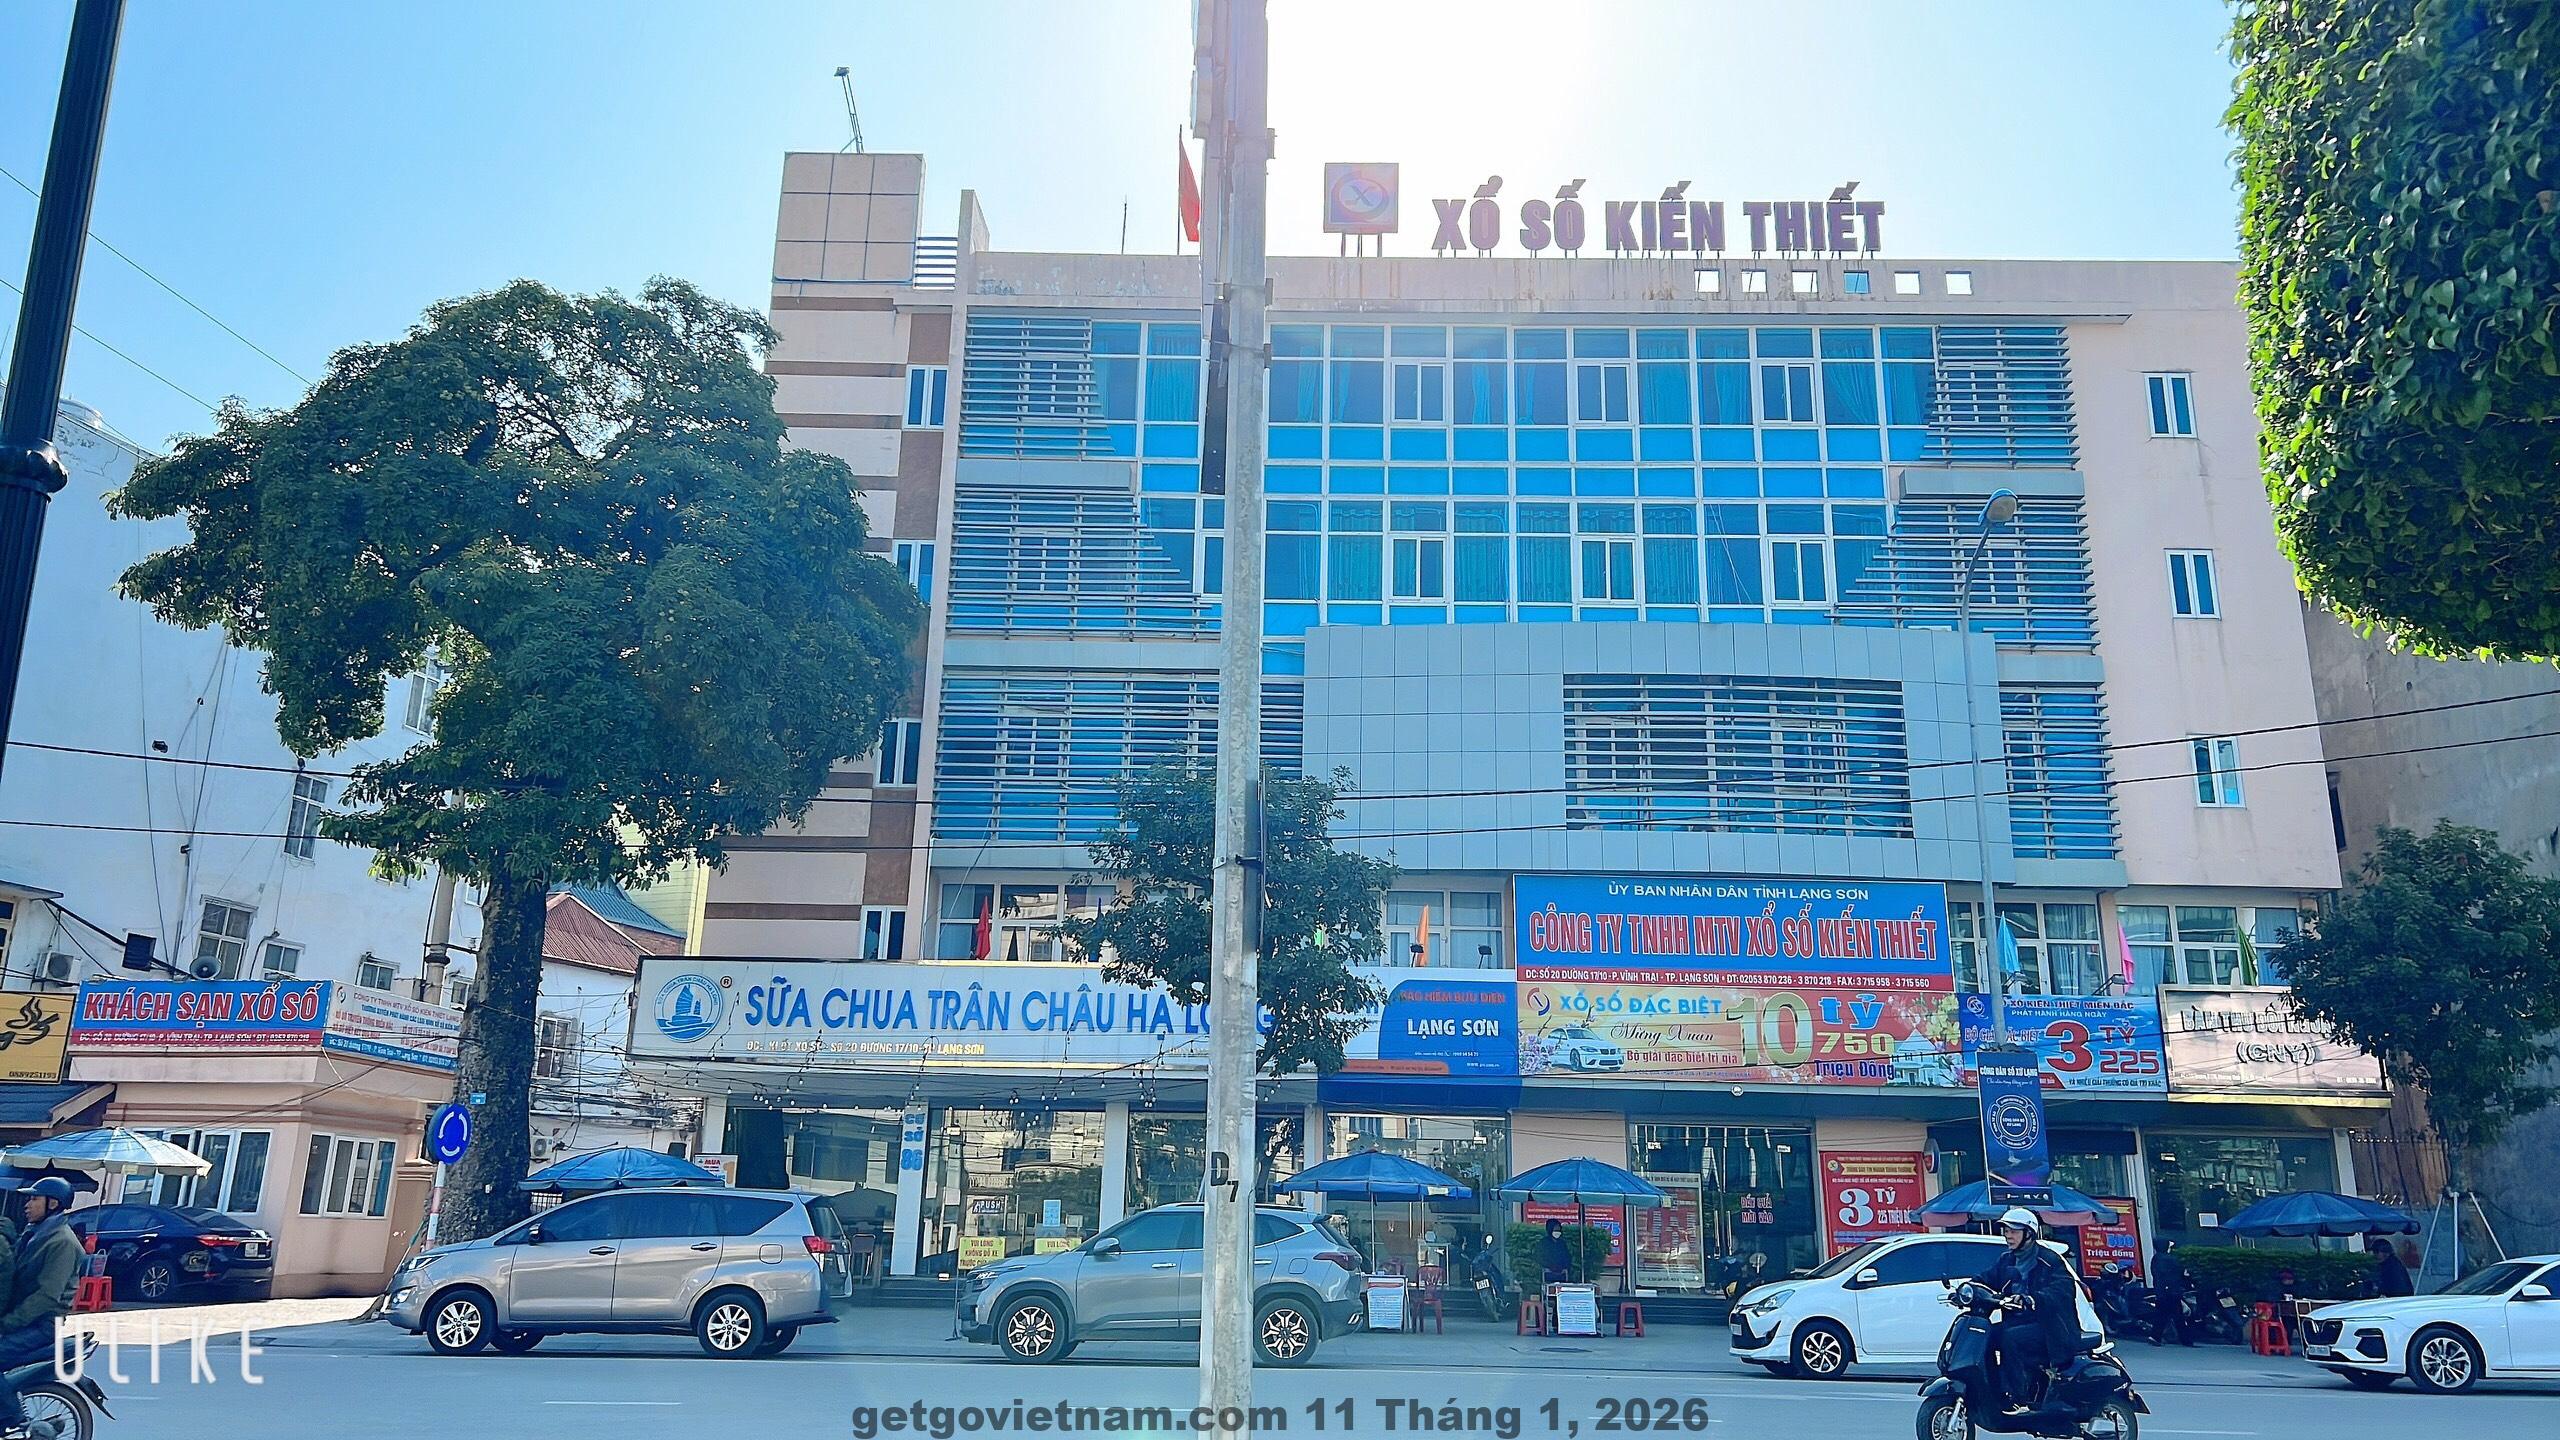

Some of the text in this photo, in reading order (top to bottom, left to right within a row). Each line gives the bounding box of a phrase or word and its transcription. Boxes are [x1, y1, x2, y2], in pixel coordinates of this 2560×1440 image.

[1431, 174, 1885, 252] XỔ SỐ KIẾN THIẾT
[1608, 880, 1869, 901] ỦY BAN NHÂN DÂN TỈNH LẠNG SƠN
[1530, 900, 1937, 960] CÔNG TY TNHH MTV XỔ SỐ KIẾN THIẾT
[1640, 972, 1659, 984] TRẠI
[1680, 973, 1701, 985] LẠNG
[1703, 972, 1719, 983] SƠN
[82, 982, 323, 1028] KHÁCH SẠN XỔ SỐ
[745, 976, 812, 1027] SỮA
[822, 987, 918, 1029] CHUA
[927, 981, 1011, 1031] TRÂN
[1021, 983, 1115, 1032] CHÂU
[1127, 993, 1174, 1041] HẠ
[1597, 987, 1623, 1012] SỐ
[1629, 994, 1672, 1017] ĐẶC
[1678, 994, 1722, 1018] BIỆT
[1407, 1018, 1499, 1039] LẠNG SƠN
[1725, 991, 1814, 1069] 10
[2098, 1019, 2136, 1045] TỶ
[1816, 1032, 1894, 1055] 750
[2045, 1019, 2093, 1073] 3
[2236, 1041, 2316, 1065] (CNY)
[1814, 1059, 1853, 1080] Triệu
[2099, 1049, 2160, 1075] 225
[1211, 1152, 1230, 1186] D
[980, 1200, 1000, 1209] PUSH
[1227, 1181, 1239, 1202] 7
[1839, 1188, 1874, 1227] 3
